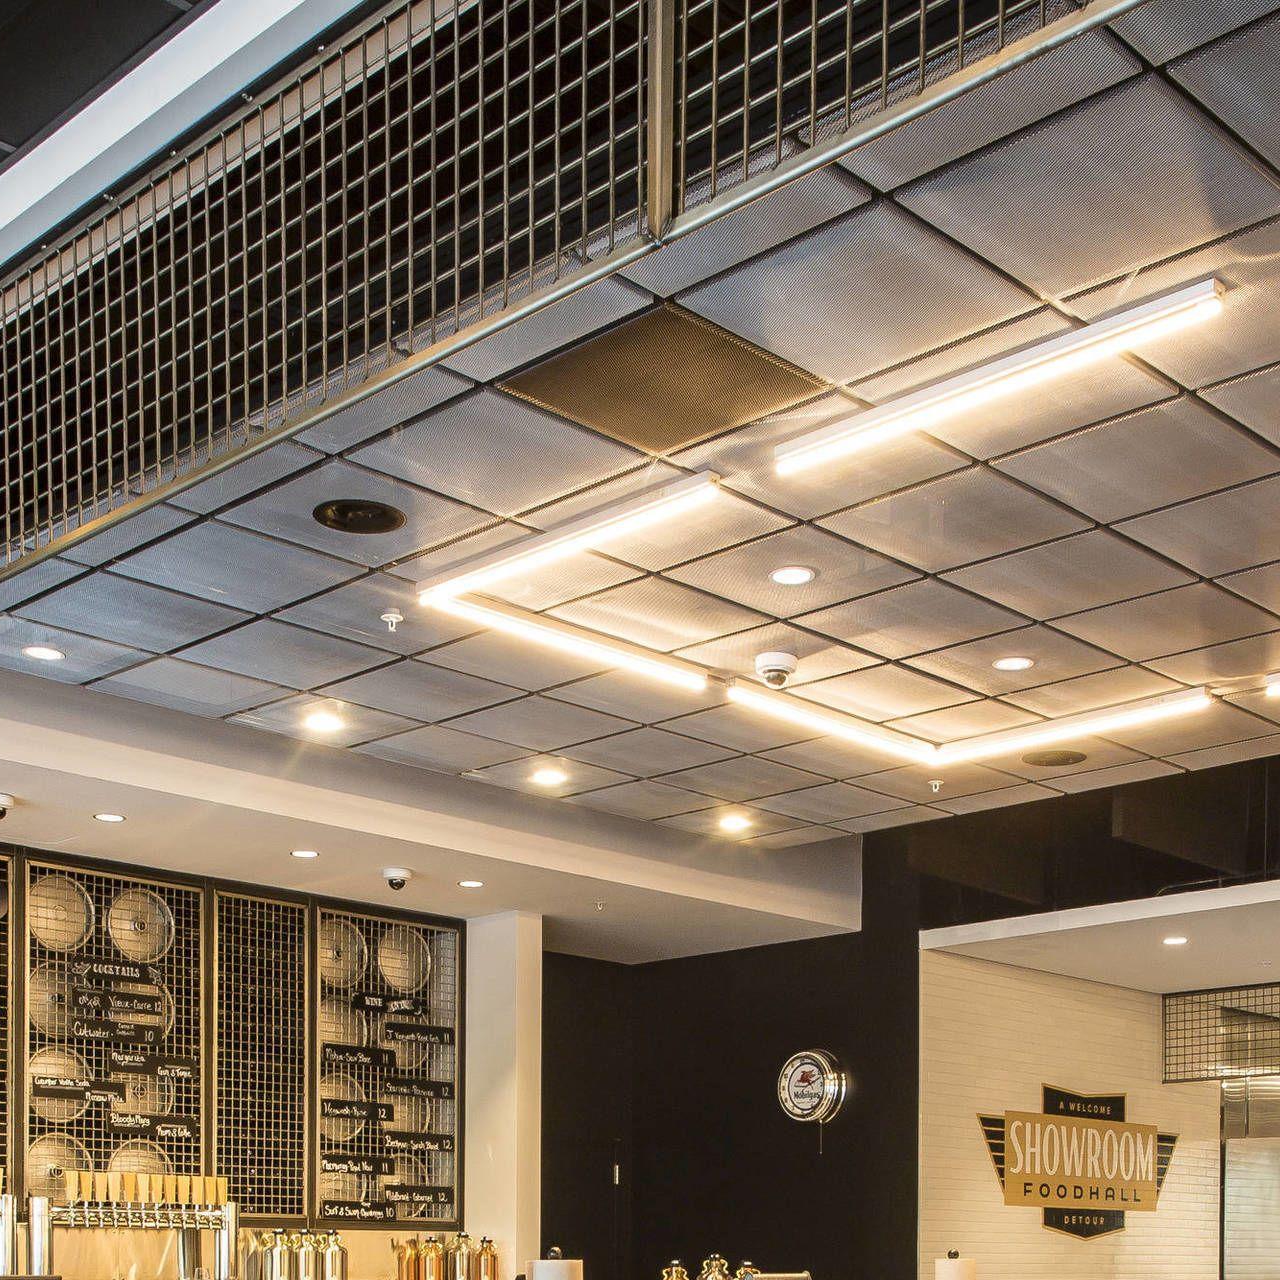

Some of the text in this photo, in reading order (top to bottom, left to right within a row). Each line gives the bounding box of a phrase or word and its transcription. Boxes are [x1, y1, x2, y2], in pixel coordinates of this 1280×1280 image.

[93, 963, 140, 978] COCKTAILS
[145, 1030, 154, 1042] 10
[378, 1108, 387, 1119] 12
[1070, 1102, 1112, 1115] WELCOME
[1010, 1120, 1153, 1182] SHOWROOM
[1023, 1182, 1141, 1202] FOODHALL
[385, 1206, 395, 1218] 10
[1064, 1215, 1105, 1225] DETOUR
